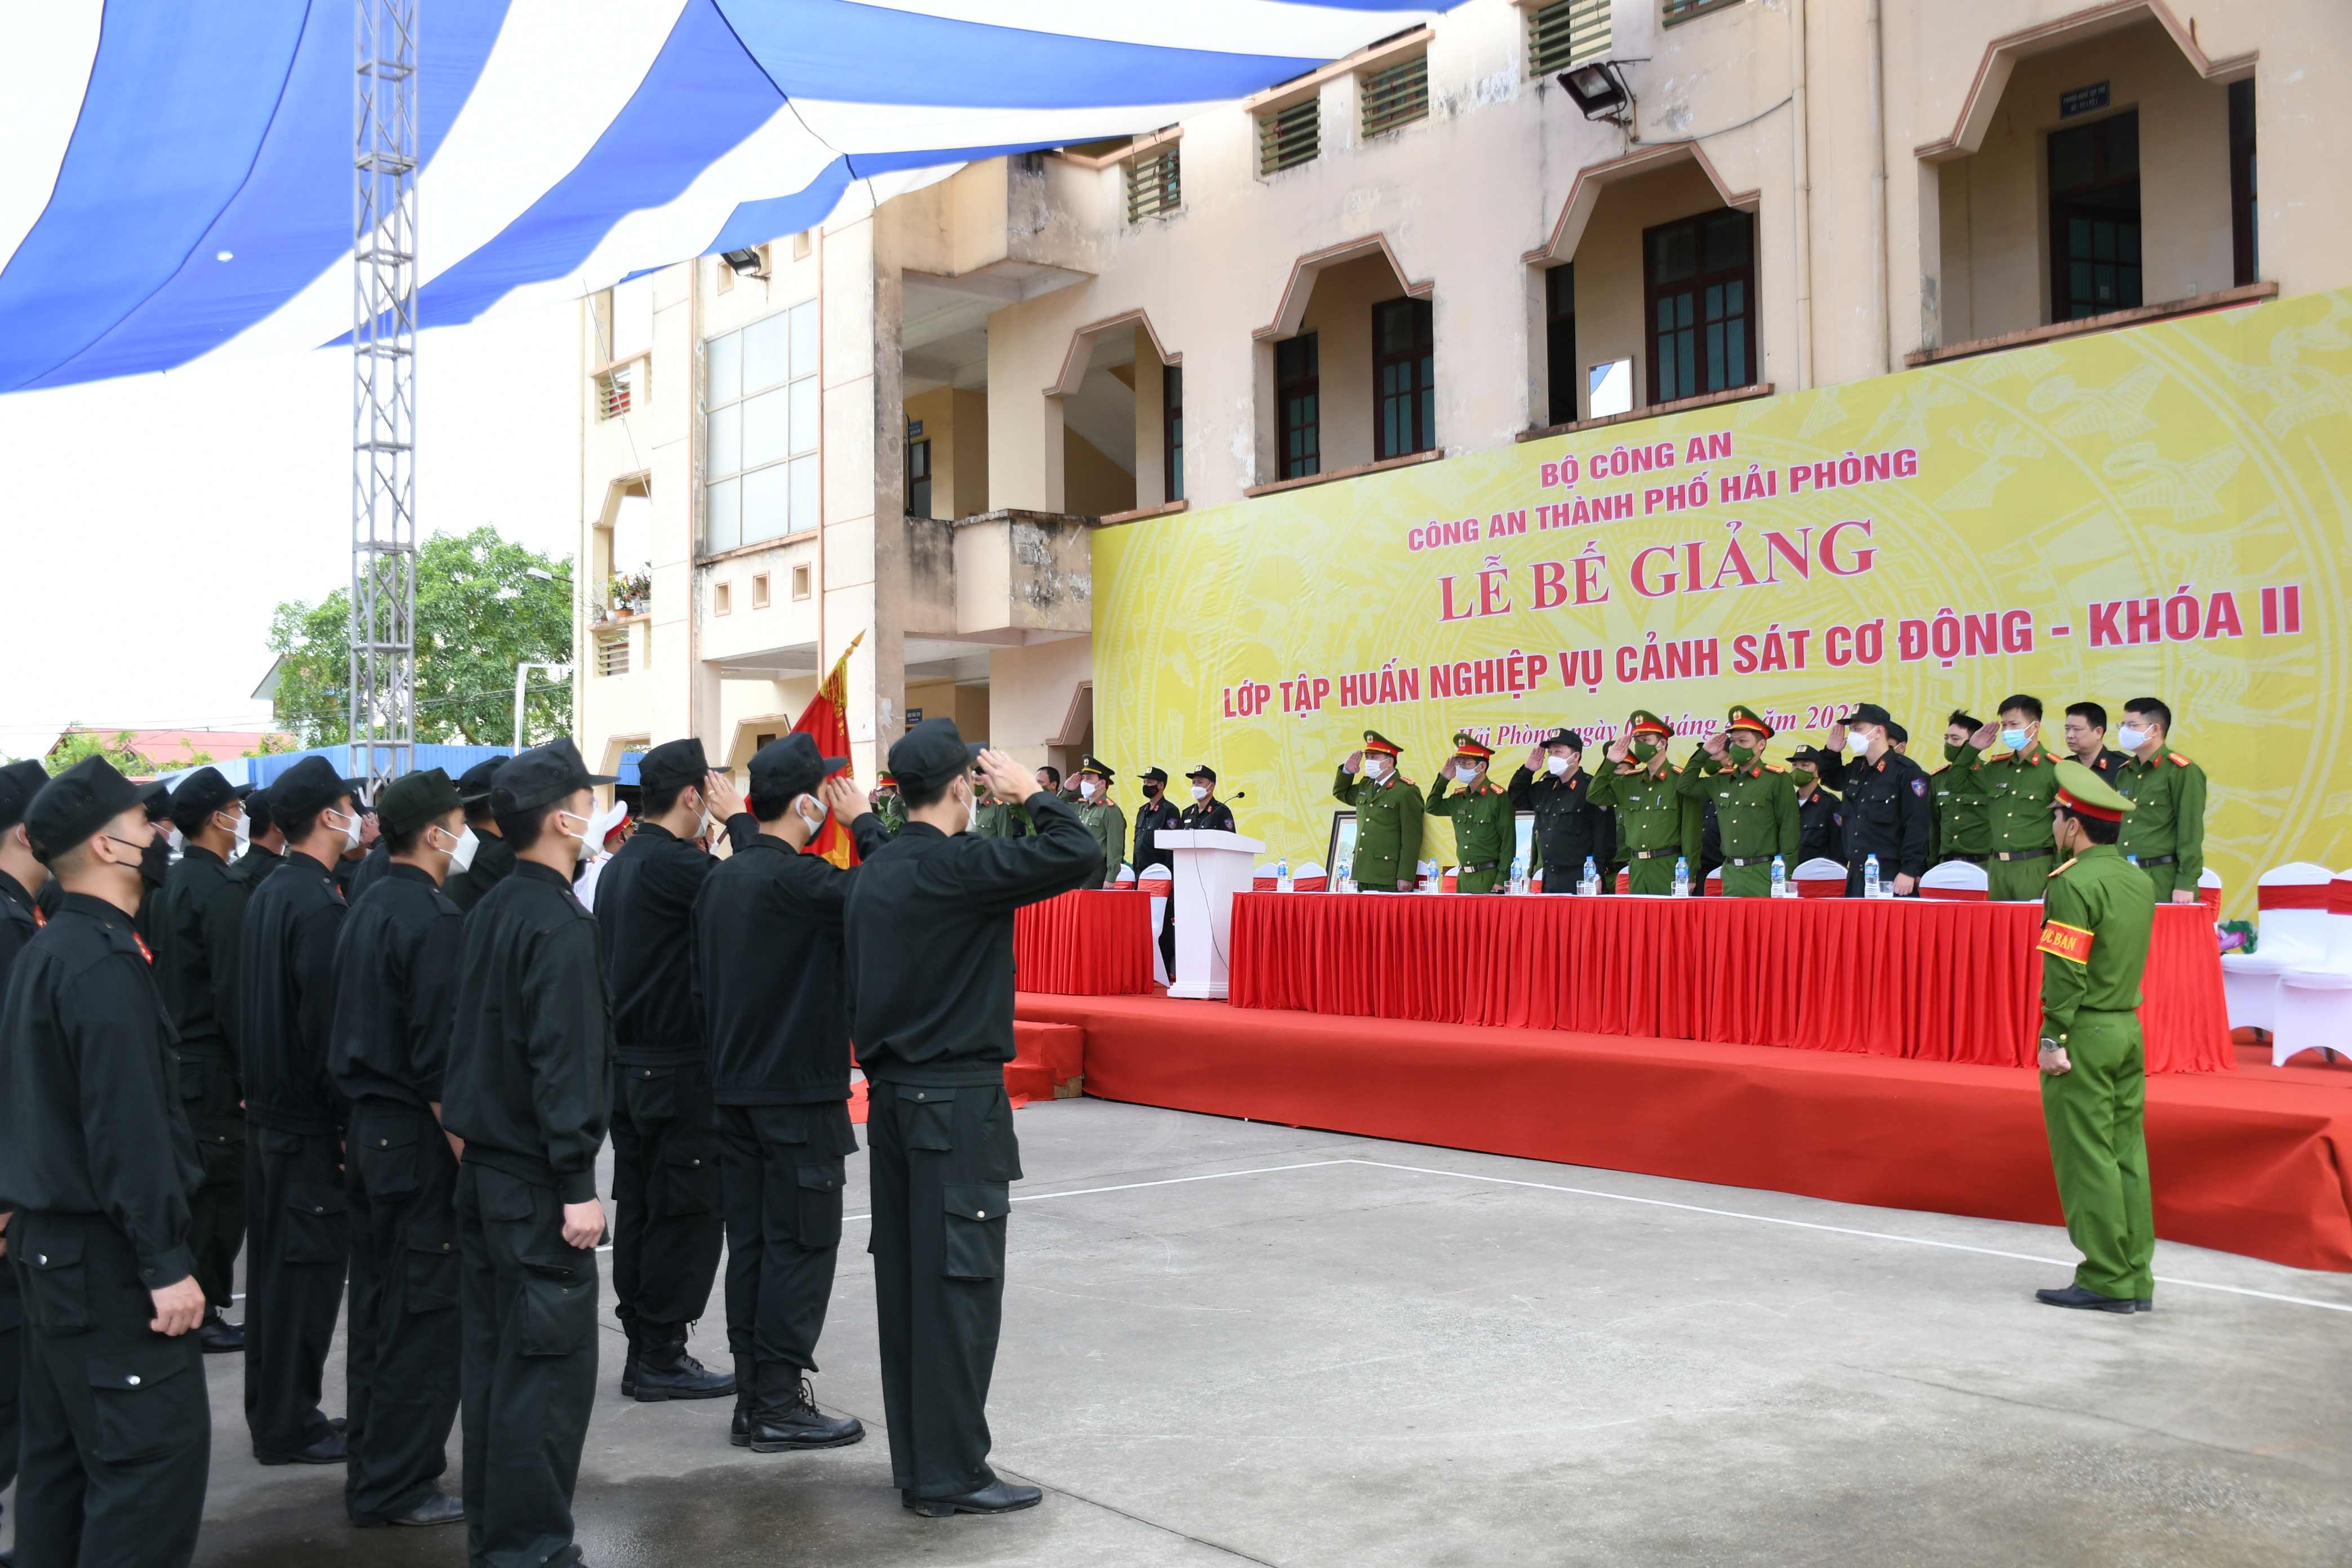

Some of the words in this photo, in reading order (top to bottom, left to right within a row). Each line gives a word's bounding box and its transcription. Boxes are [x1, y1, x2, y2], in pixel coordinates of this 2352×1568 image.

[1542, 455, 1579, 487] BỘ
[1590, 443, 1674, 479] CÔNG
[1686, 432, 1732, 463] AN
[1408, 518, 1480, 551] CÔNG
[1489, 510, 1526, 538] AN
[1536, 493, 1633, 529] THÀNH
[1645, 476, 1708, 514] PHỐ
[1721, 464, 1777, 502] HẢI
[1790, 449, 1917, 493] PHÒNG
[1437, 554, 1512, 622] LỄ
[1529, 540, 1610, 611] BẾ
[1630, 519, 1877, 598] GIẢNG
[1224, 680, 1271, 718] LỚP
[1280, 673, 1330, 718] TẬP
[1340, 658, 1419, 707] HUẤN
[1430, 649, 1548, 699] NGHIỆP
[1559, 649, 1603, 693] VỤ
[1616, 631, 1718, 683] CẢNH
[1734, 624, 1810, 674] SÁT
[1825, 618, 1884, 666] CƠ
[1898, 608, 2033, 667] ĐỘNG
[2090, 585, 2243, 647] KHÓA
[2262, 586, 2300, 634] II
[1570, 719, 1617, 747] ngày
[1659, 714, 1718, 741] háng
[1758, 708, 1797, 731] ăm
[1805, 704, 1851, 729] 202
[2052, 932, 2077, 951] BAN
